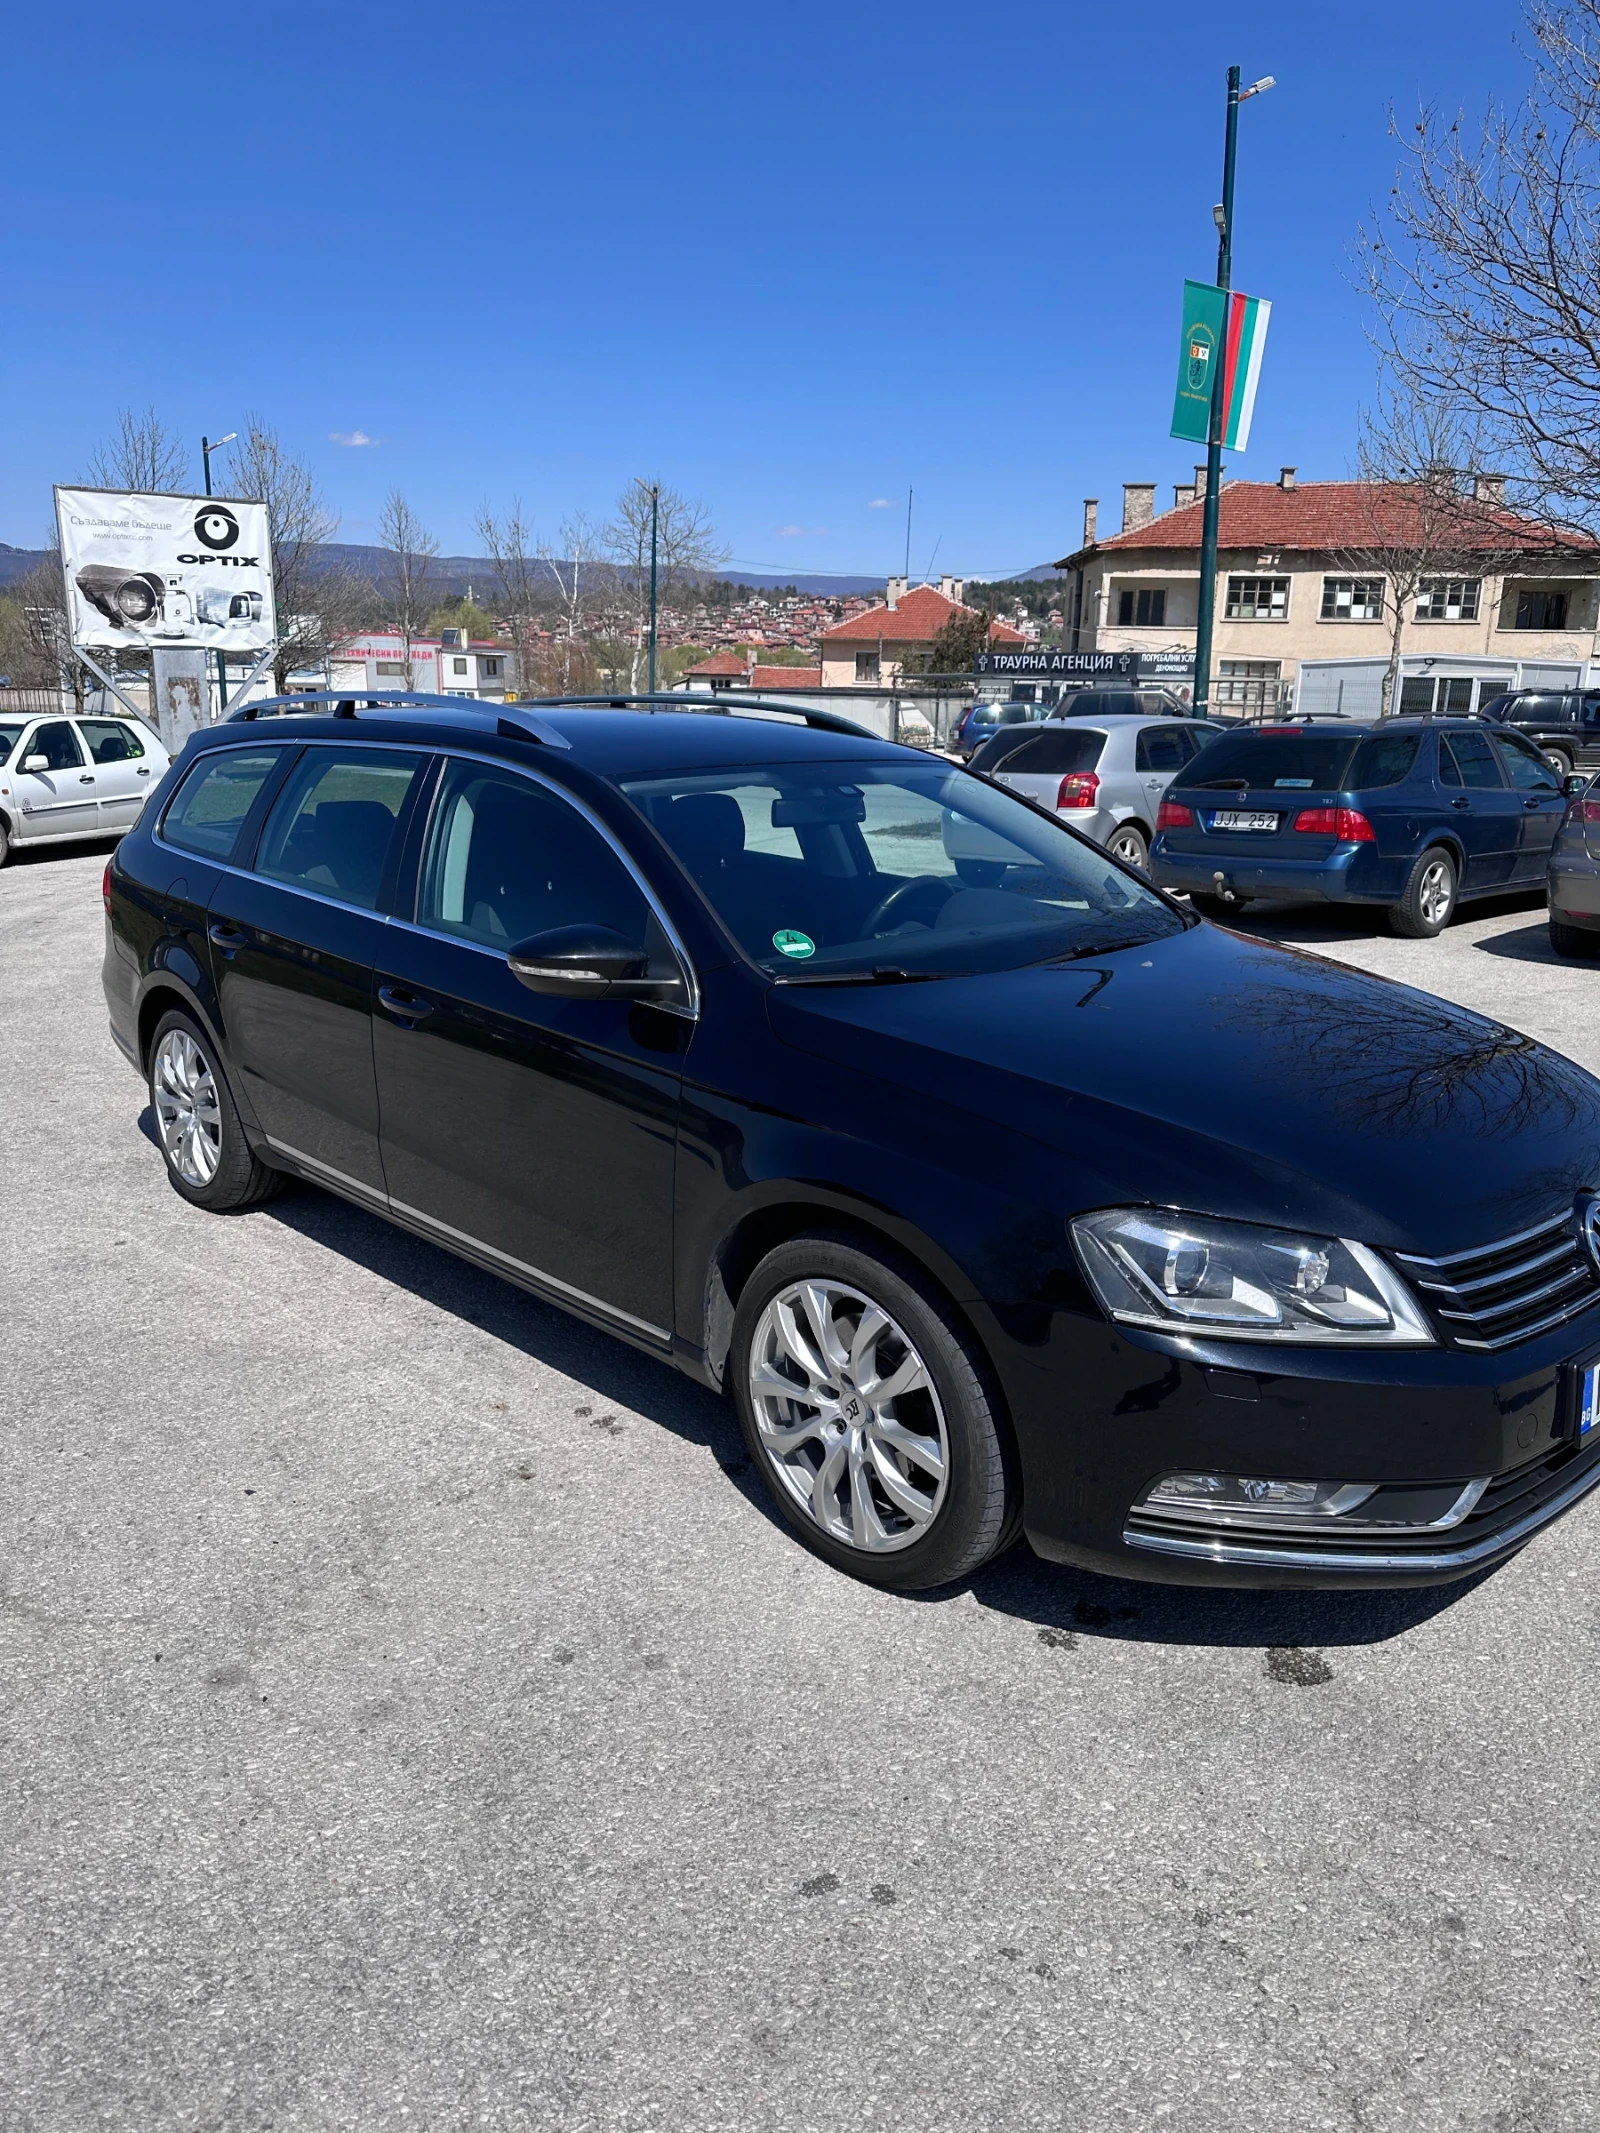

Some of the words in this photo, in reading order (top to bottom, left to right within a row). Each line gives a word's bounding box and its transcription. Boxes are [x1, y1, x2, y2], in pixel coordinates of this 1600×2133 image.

[70, 515, 130, 528] Създаваме
[176, 554, 260, 568] OPTIX
[993, 655, 1047, 670] ТРАУРНА
[1052, 655, 1114, 673] АГЕНЦИЯ
[1141, 653, 1180, 663] ПОГРЕБАЛНИ
[1155, 664, 1188, 673] ДЕНОНОЩНО
[1215, 812, 1241, 827] JJX
[1248, 814, 1275, 828] 252
[1581, 1406, 1591, 1426] BG
